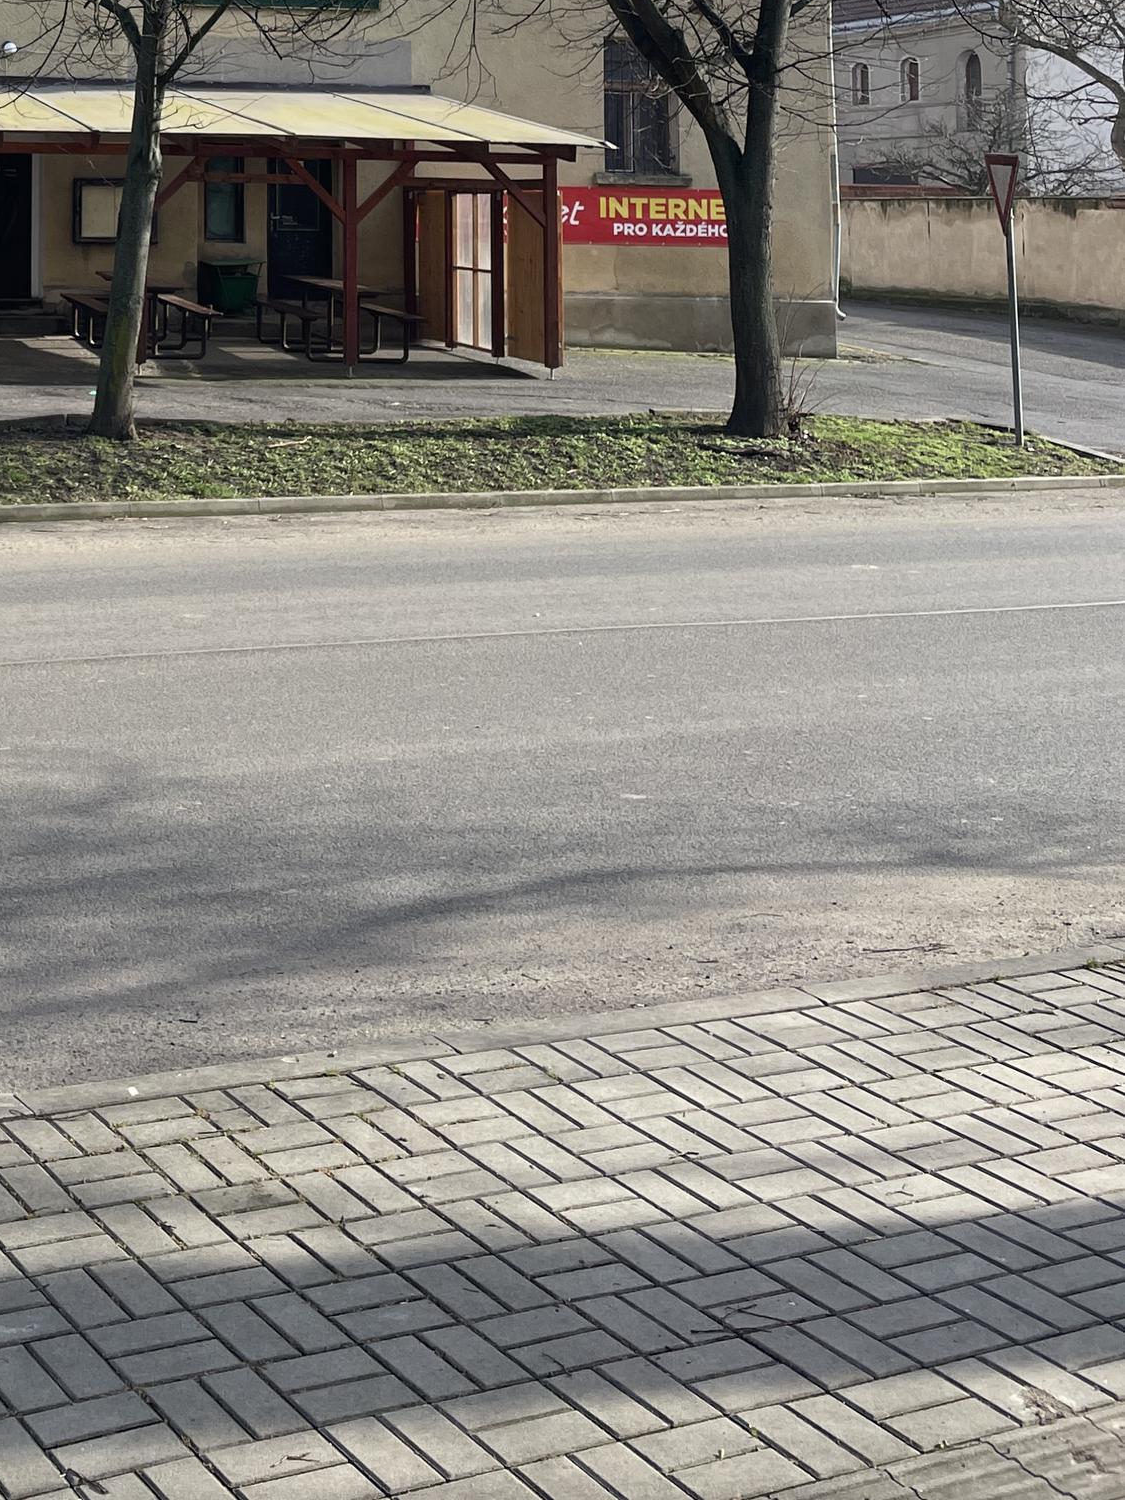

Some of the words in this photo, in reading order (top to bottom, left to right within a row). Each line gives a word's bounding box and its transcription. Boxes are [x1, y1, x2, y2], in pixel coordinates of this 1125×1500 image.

[599, 196, 727, 221] INTERNE
[613, 222, 648, 236] PRO
[652, 220, 729, 238] KAŽDÉHO
